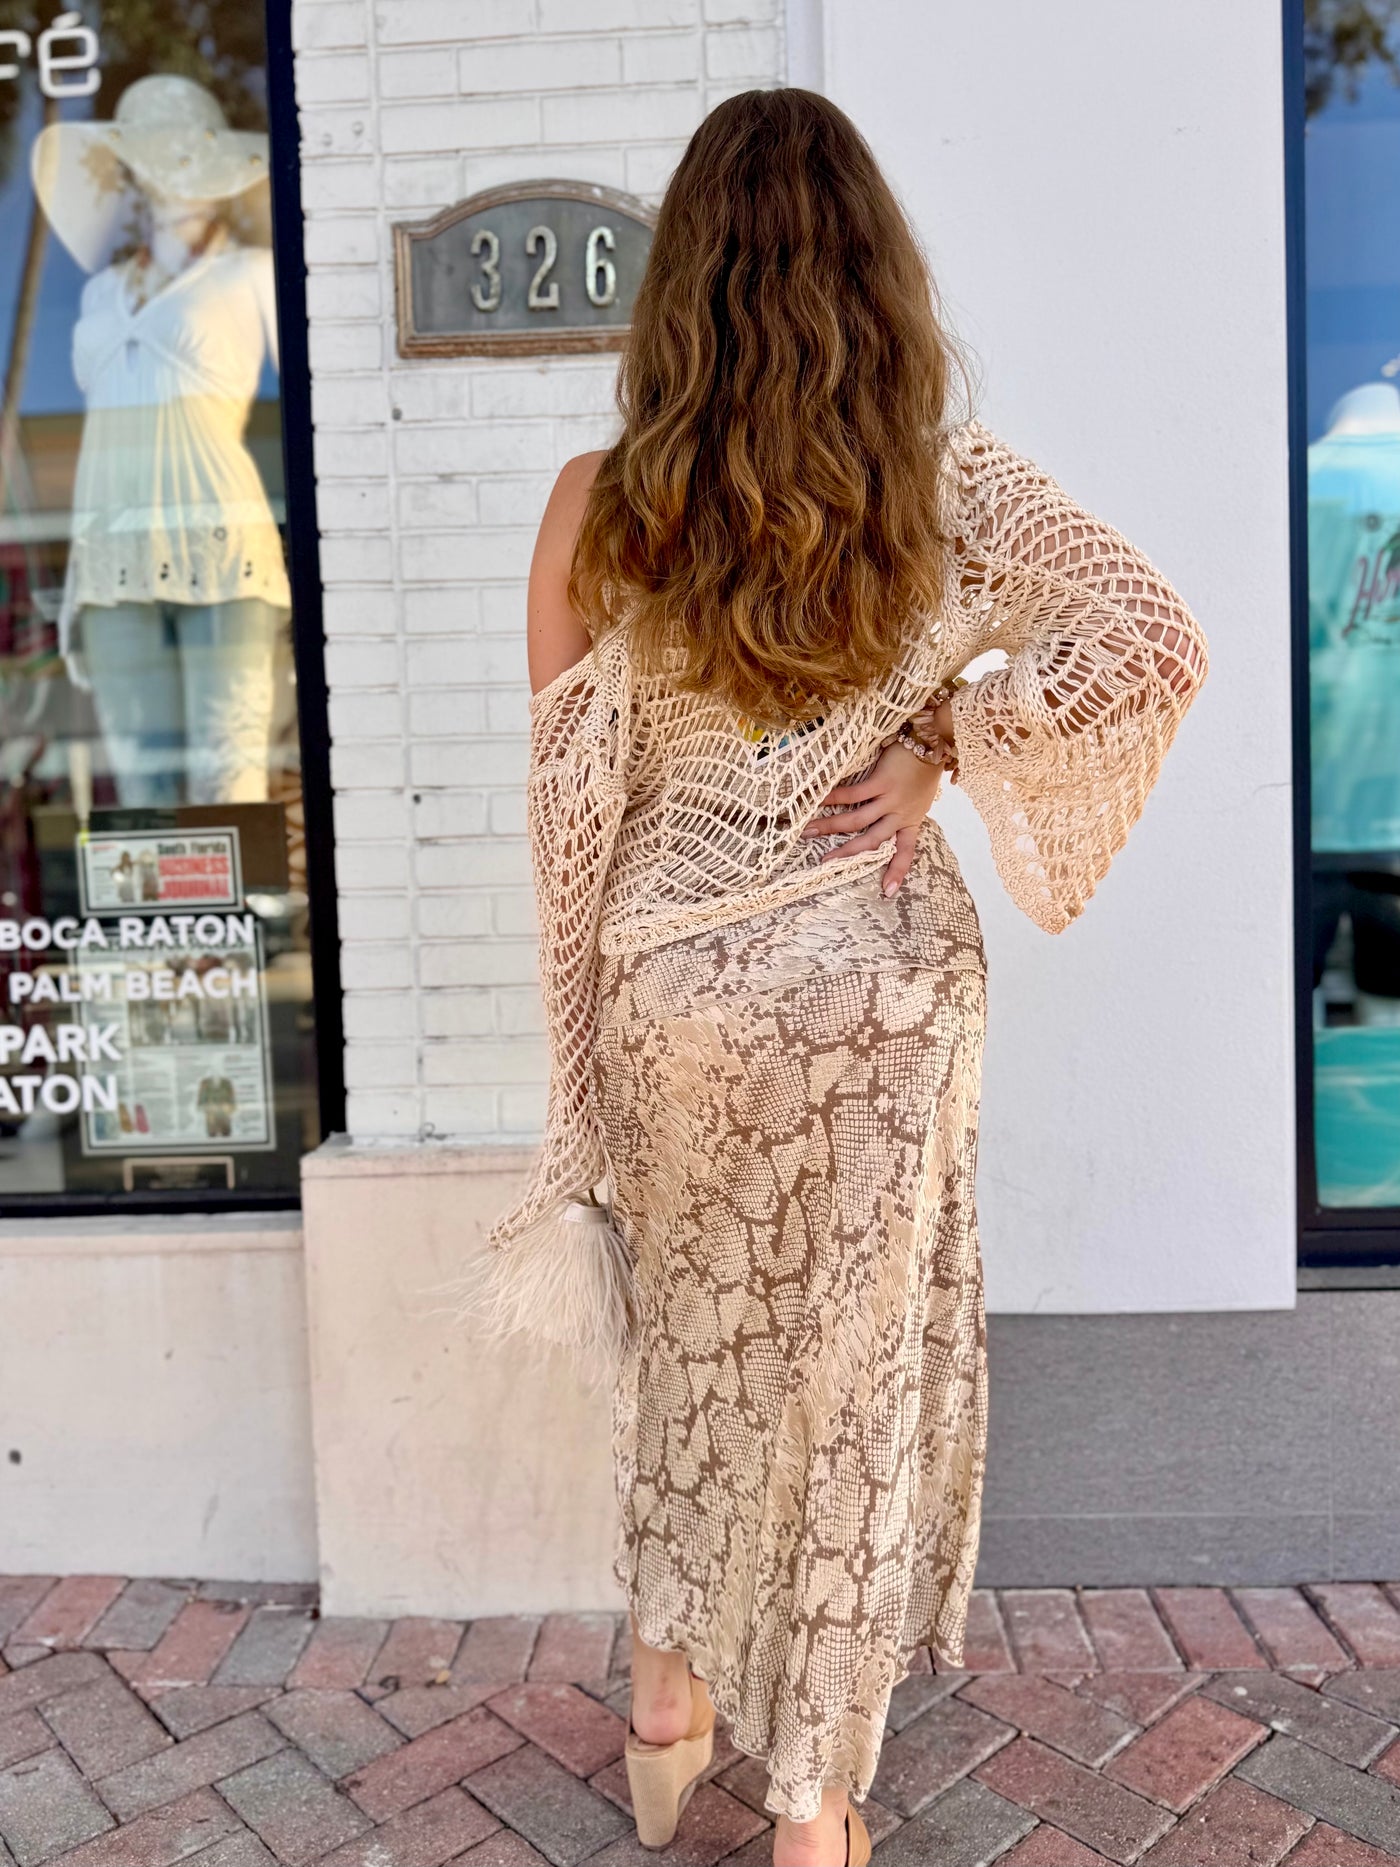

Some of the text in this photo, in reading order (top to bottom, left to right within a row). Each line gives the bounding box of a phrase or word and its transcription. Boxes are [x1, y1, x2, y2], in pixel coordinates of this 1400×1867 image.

[471, 225, 617, 312] 326
[0, 914, 254, 950] BOCA RATON
[8, 966, 257, 1004] PALM BEACH
[0, 1023, 122, 1065] PARK
